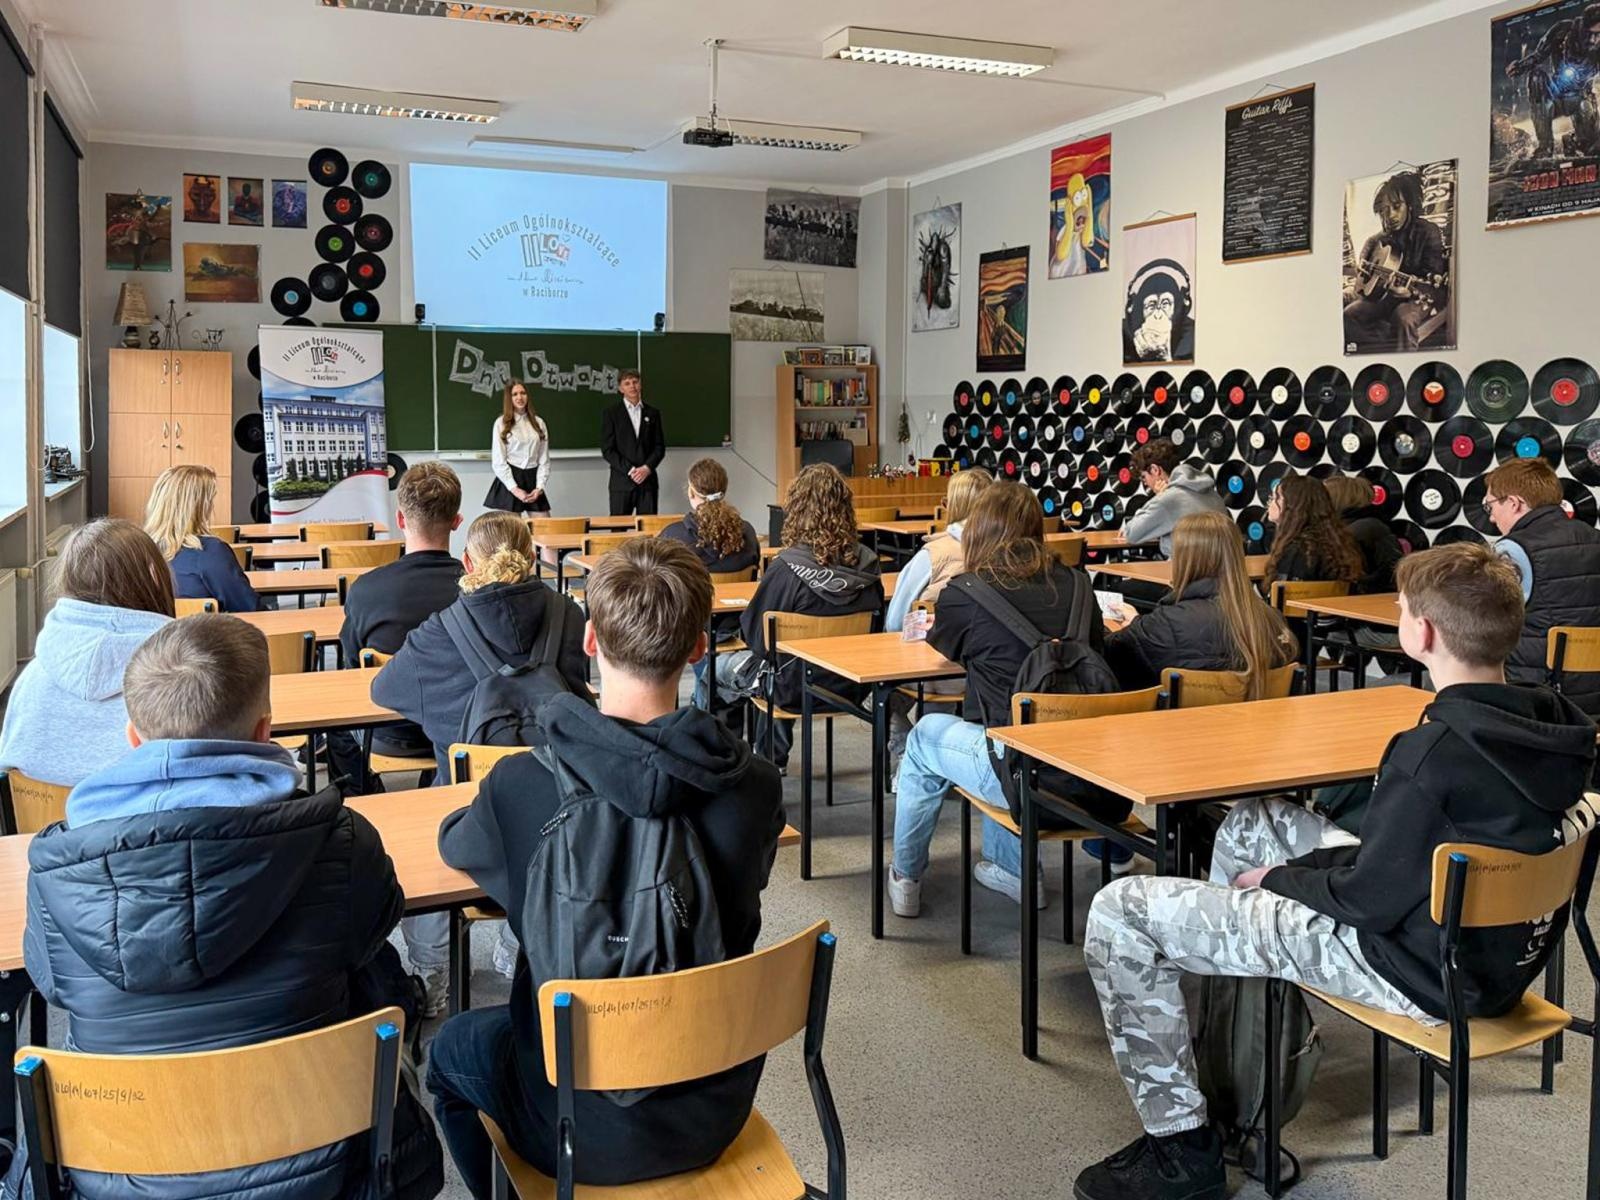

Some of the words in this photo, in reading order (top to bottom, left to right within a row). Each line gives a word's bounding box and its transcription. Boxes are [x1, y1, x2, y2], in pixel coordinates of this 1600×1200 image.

[1242, 104, 1270, 120] Guitar
[1272, 96, 1292, 115] Riffs
[1523, 171, 1559, 193] IRON
[1561, 164, 1597, 186] MAN
[467, 246, 482, 261] II
[478, 220, 520, 250] Liceum
[523, 213, 621, 267] Ogólnokształcące
[456, 348, 511, 386] Dni
[526, 357, 614, 390] Otwart
